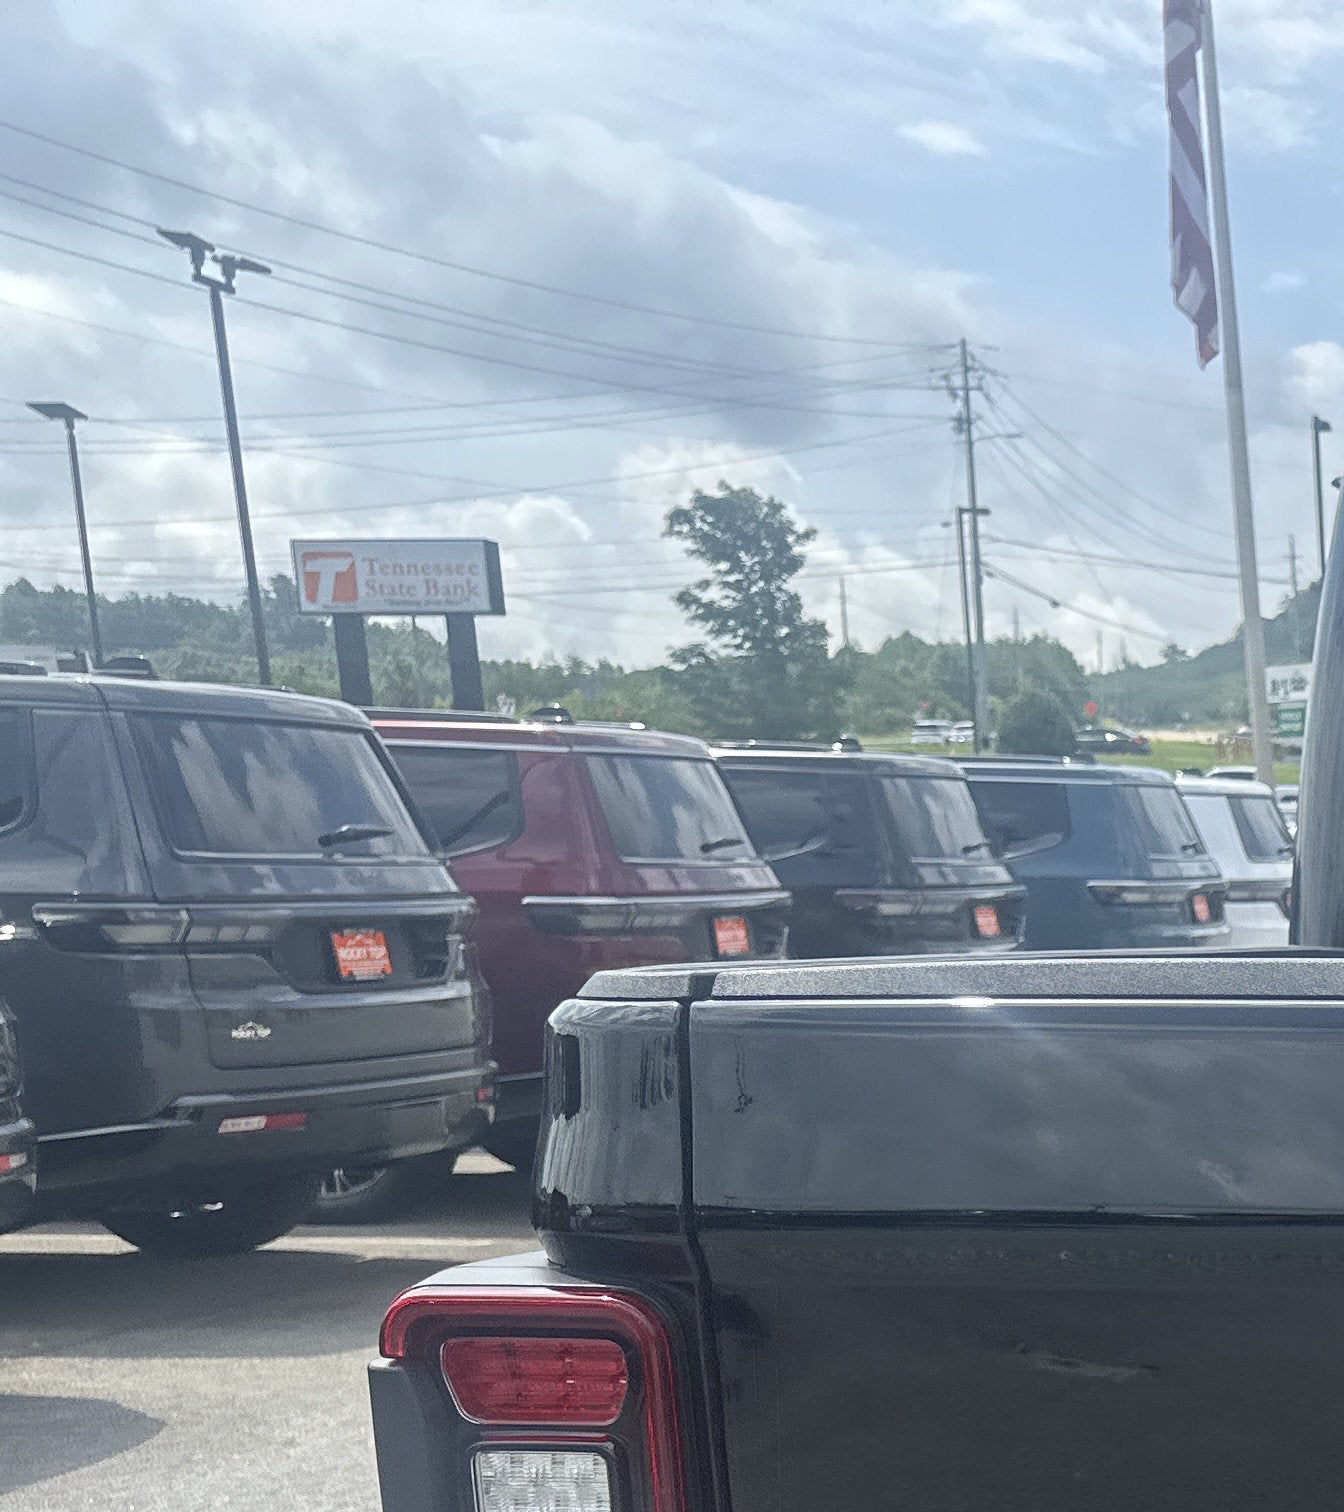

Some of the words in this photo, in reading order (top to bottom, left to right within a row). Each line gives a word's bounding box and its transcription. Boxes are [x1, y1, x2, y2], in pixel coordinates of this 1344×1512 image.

[362, 556, 481, 578] Tennessee
[364, 579, 417, 599] State
[422, 578, 481, 600] Bank
